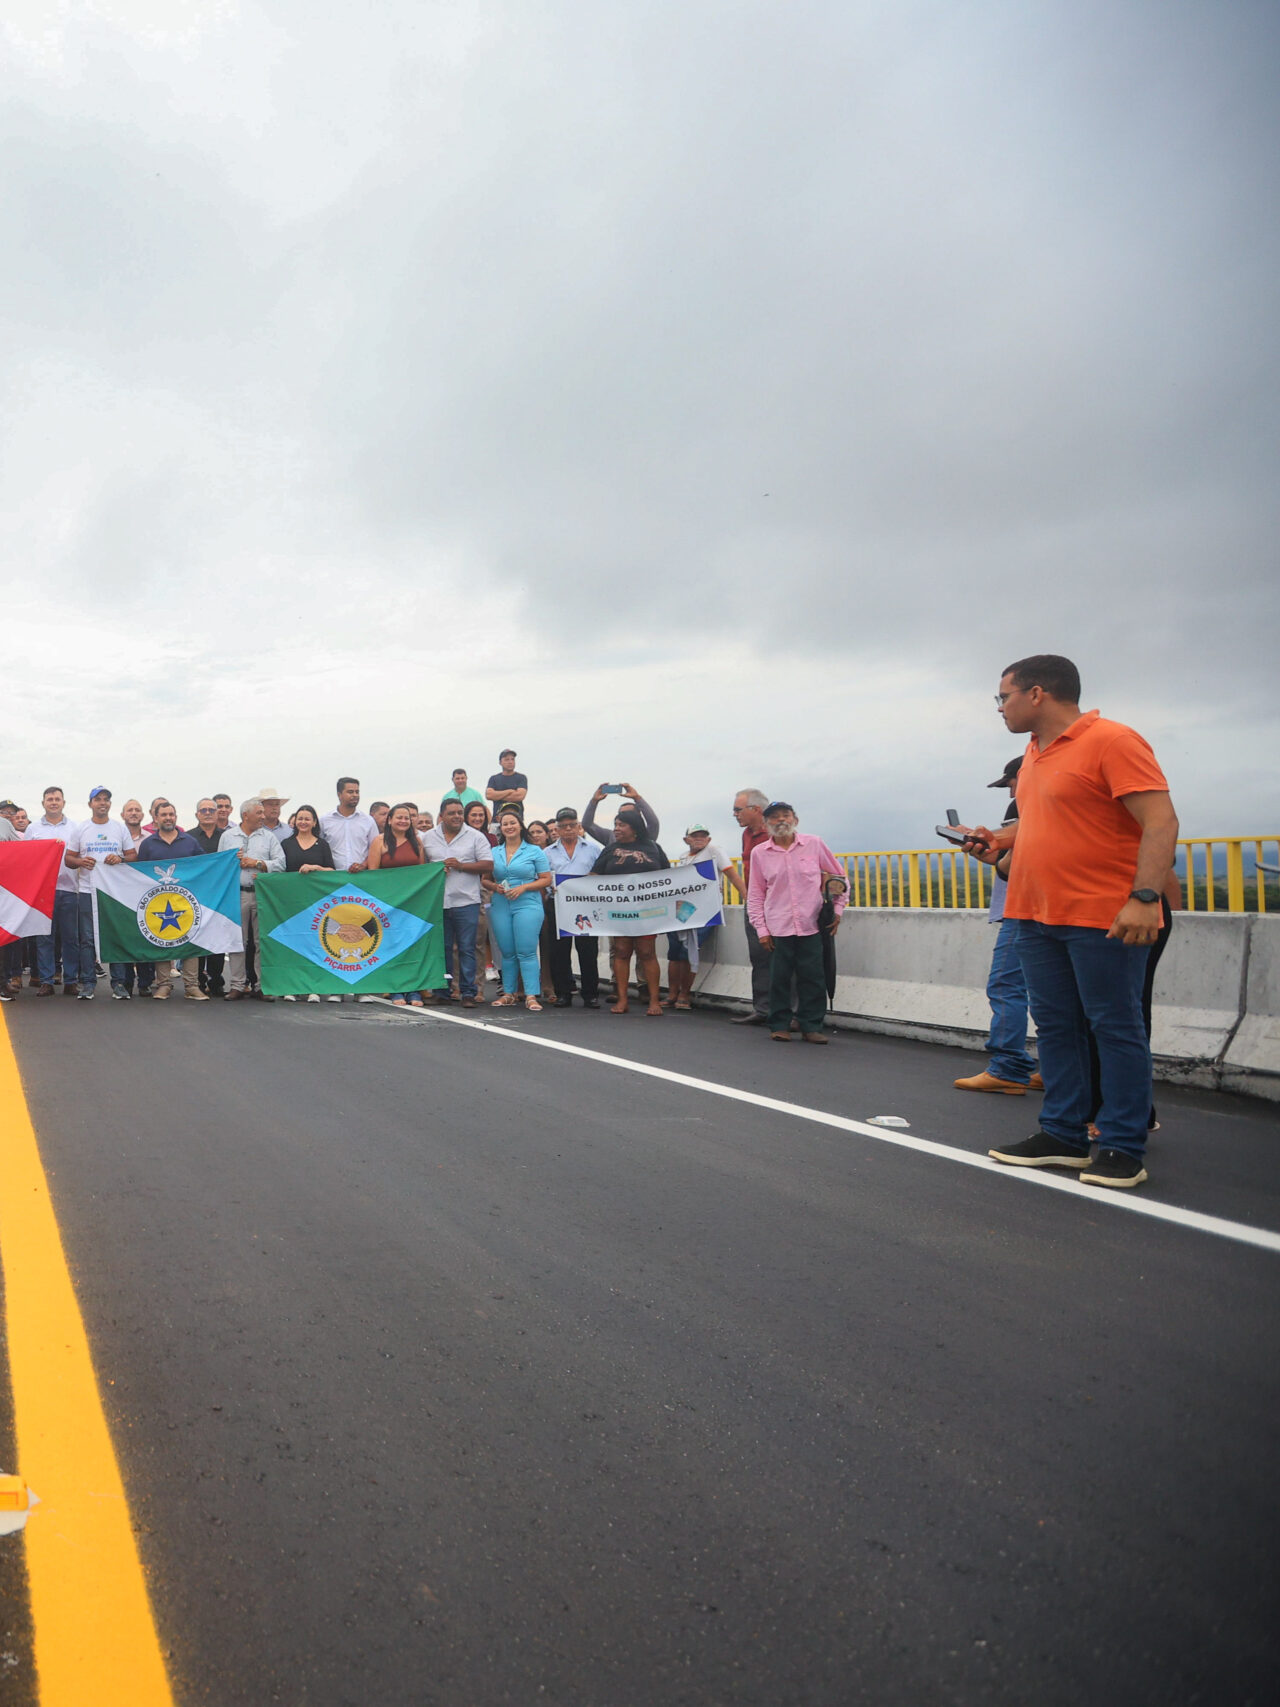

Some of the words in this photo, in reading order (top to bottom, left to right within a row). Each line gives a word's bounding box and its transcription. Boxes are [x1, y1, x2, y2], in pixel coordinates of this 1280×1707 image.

[565, 895, 614, 903] DINHEIRO
[633, 883, 708, 903] INDENIZAÇÃO?
[638, 878, 672, 891] NOSSO
[148, 886, 178, 897] GERALDO
[179, 888, 188, 896] DO
[187, 895, 200, 926] ARAGUAIA
[341, 895, 390, 928] PROGRESSO
[142, 927, 150, 936] DE
[149, 935, 164, 945] MAIO
